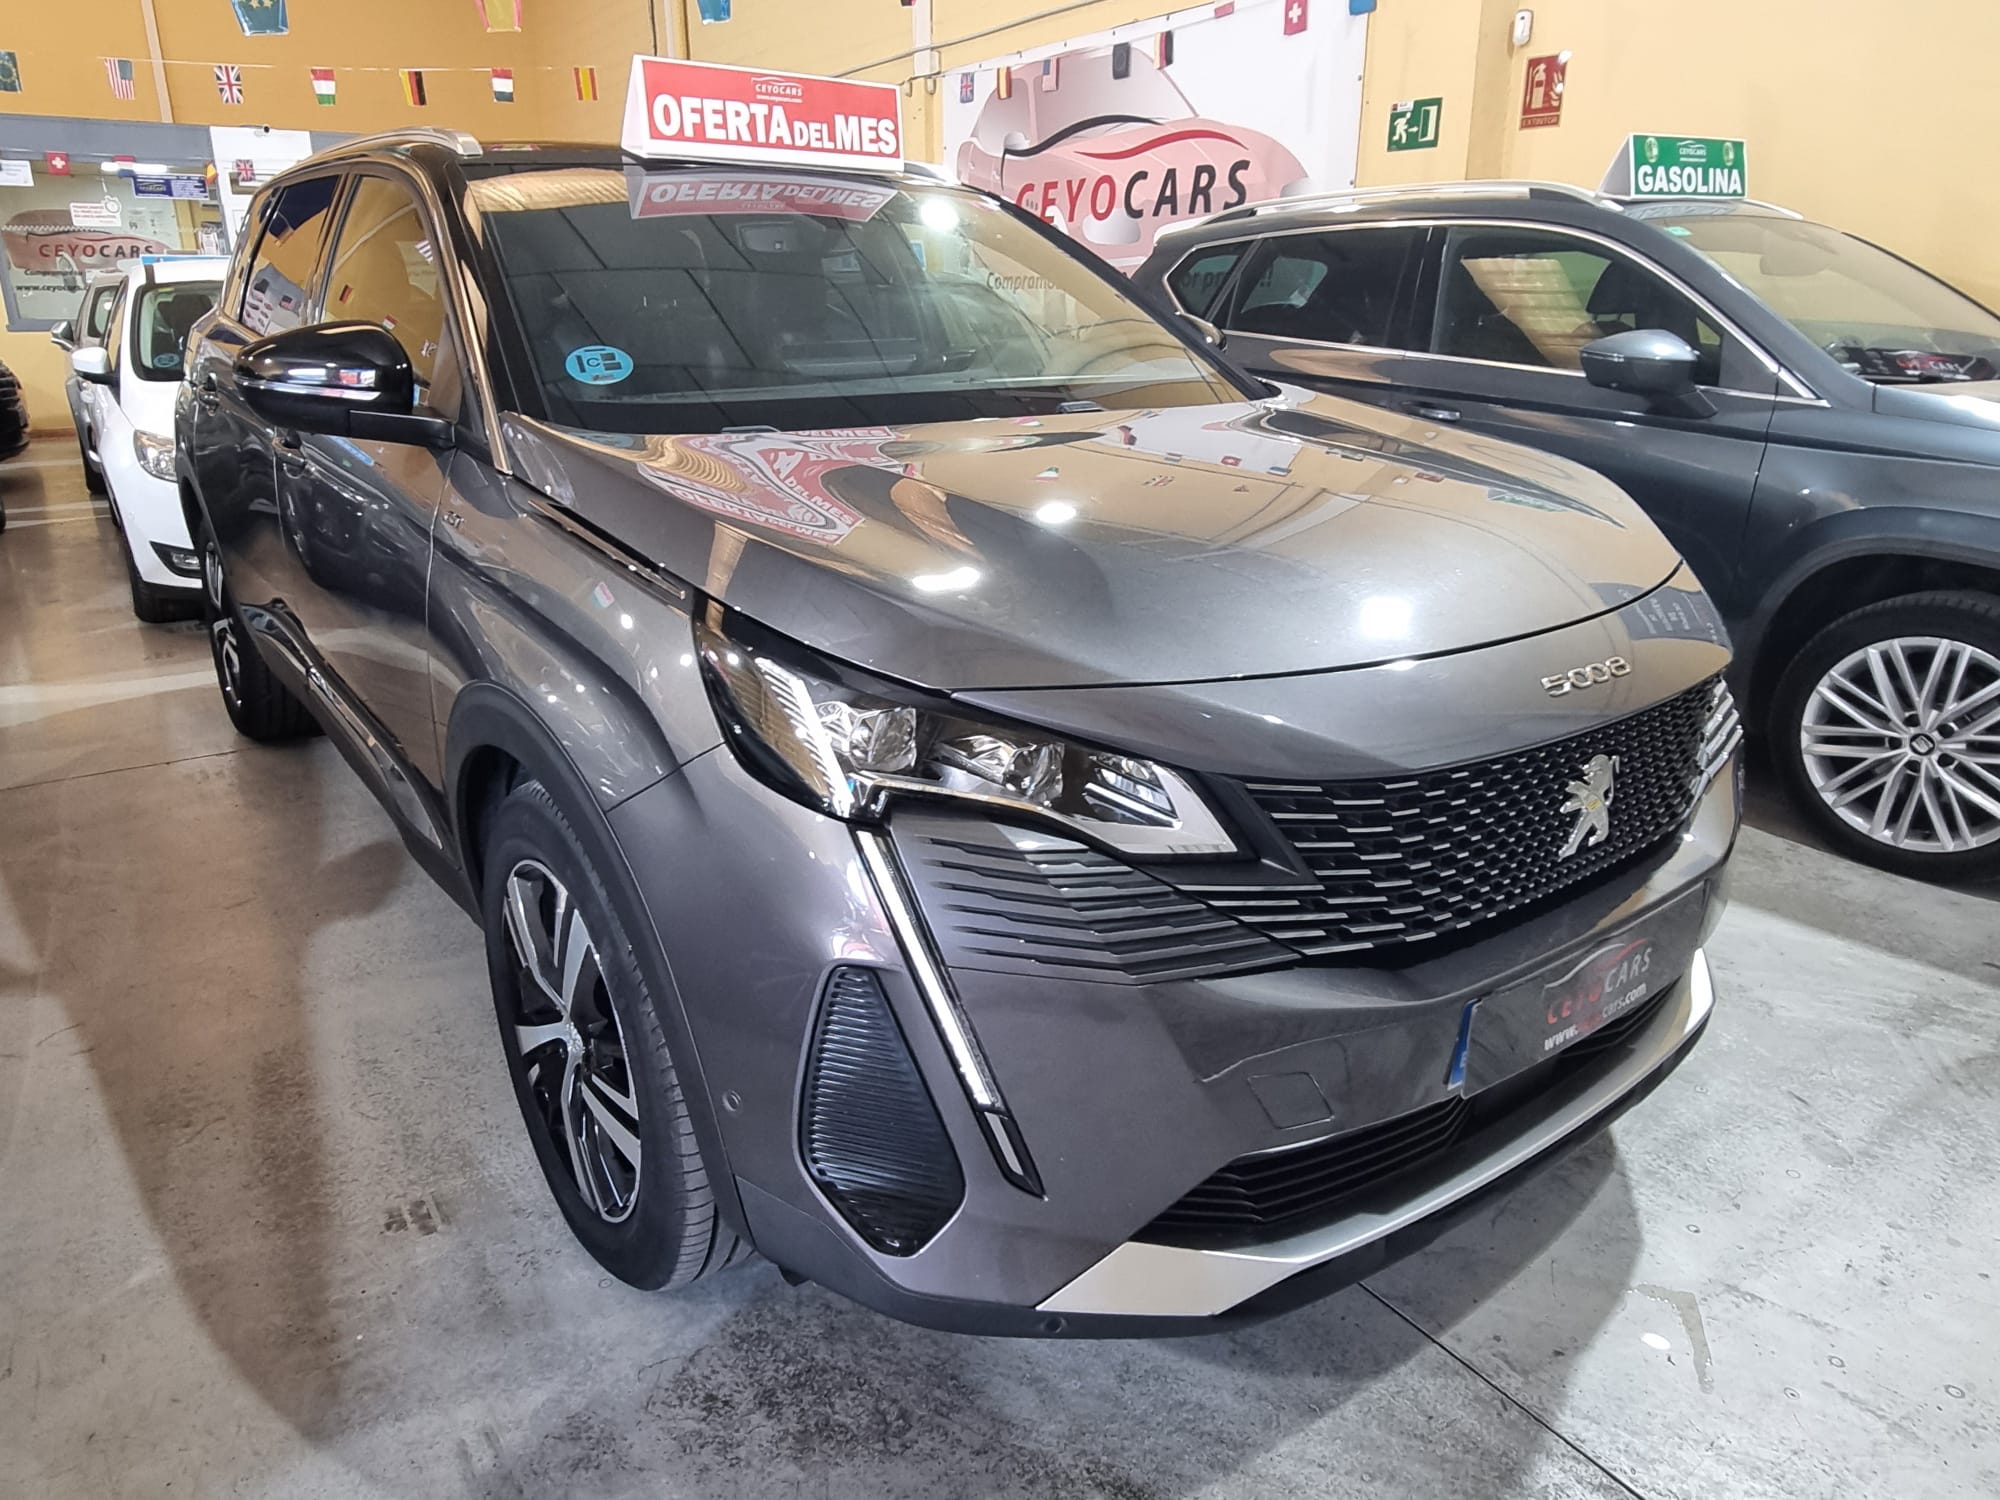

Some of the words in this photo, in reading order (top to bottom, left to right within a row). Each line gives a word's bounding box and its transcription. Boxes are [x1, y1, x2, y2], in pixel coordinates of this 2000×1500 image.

[652, 94, 792, 145] OFERTA
[793, 121, 836, 149] DEL
[834, 114, 897, 154] MES
[1014, 159, 1251, 225] CEYOCARS
[1637, 165, 1742, 194] GASOLINA
[39, 244, 154, 258] CEYOCARS
[986, 272, 1056, 294] Compramo
[1540, 656, 1631, 697] 5008
[1545, 946, 1653, 1025] CEOCARS
[1543, 982, 1648, 1051] www.cars.com
